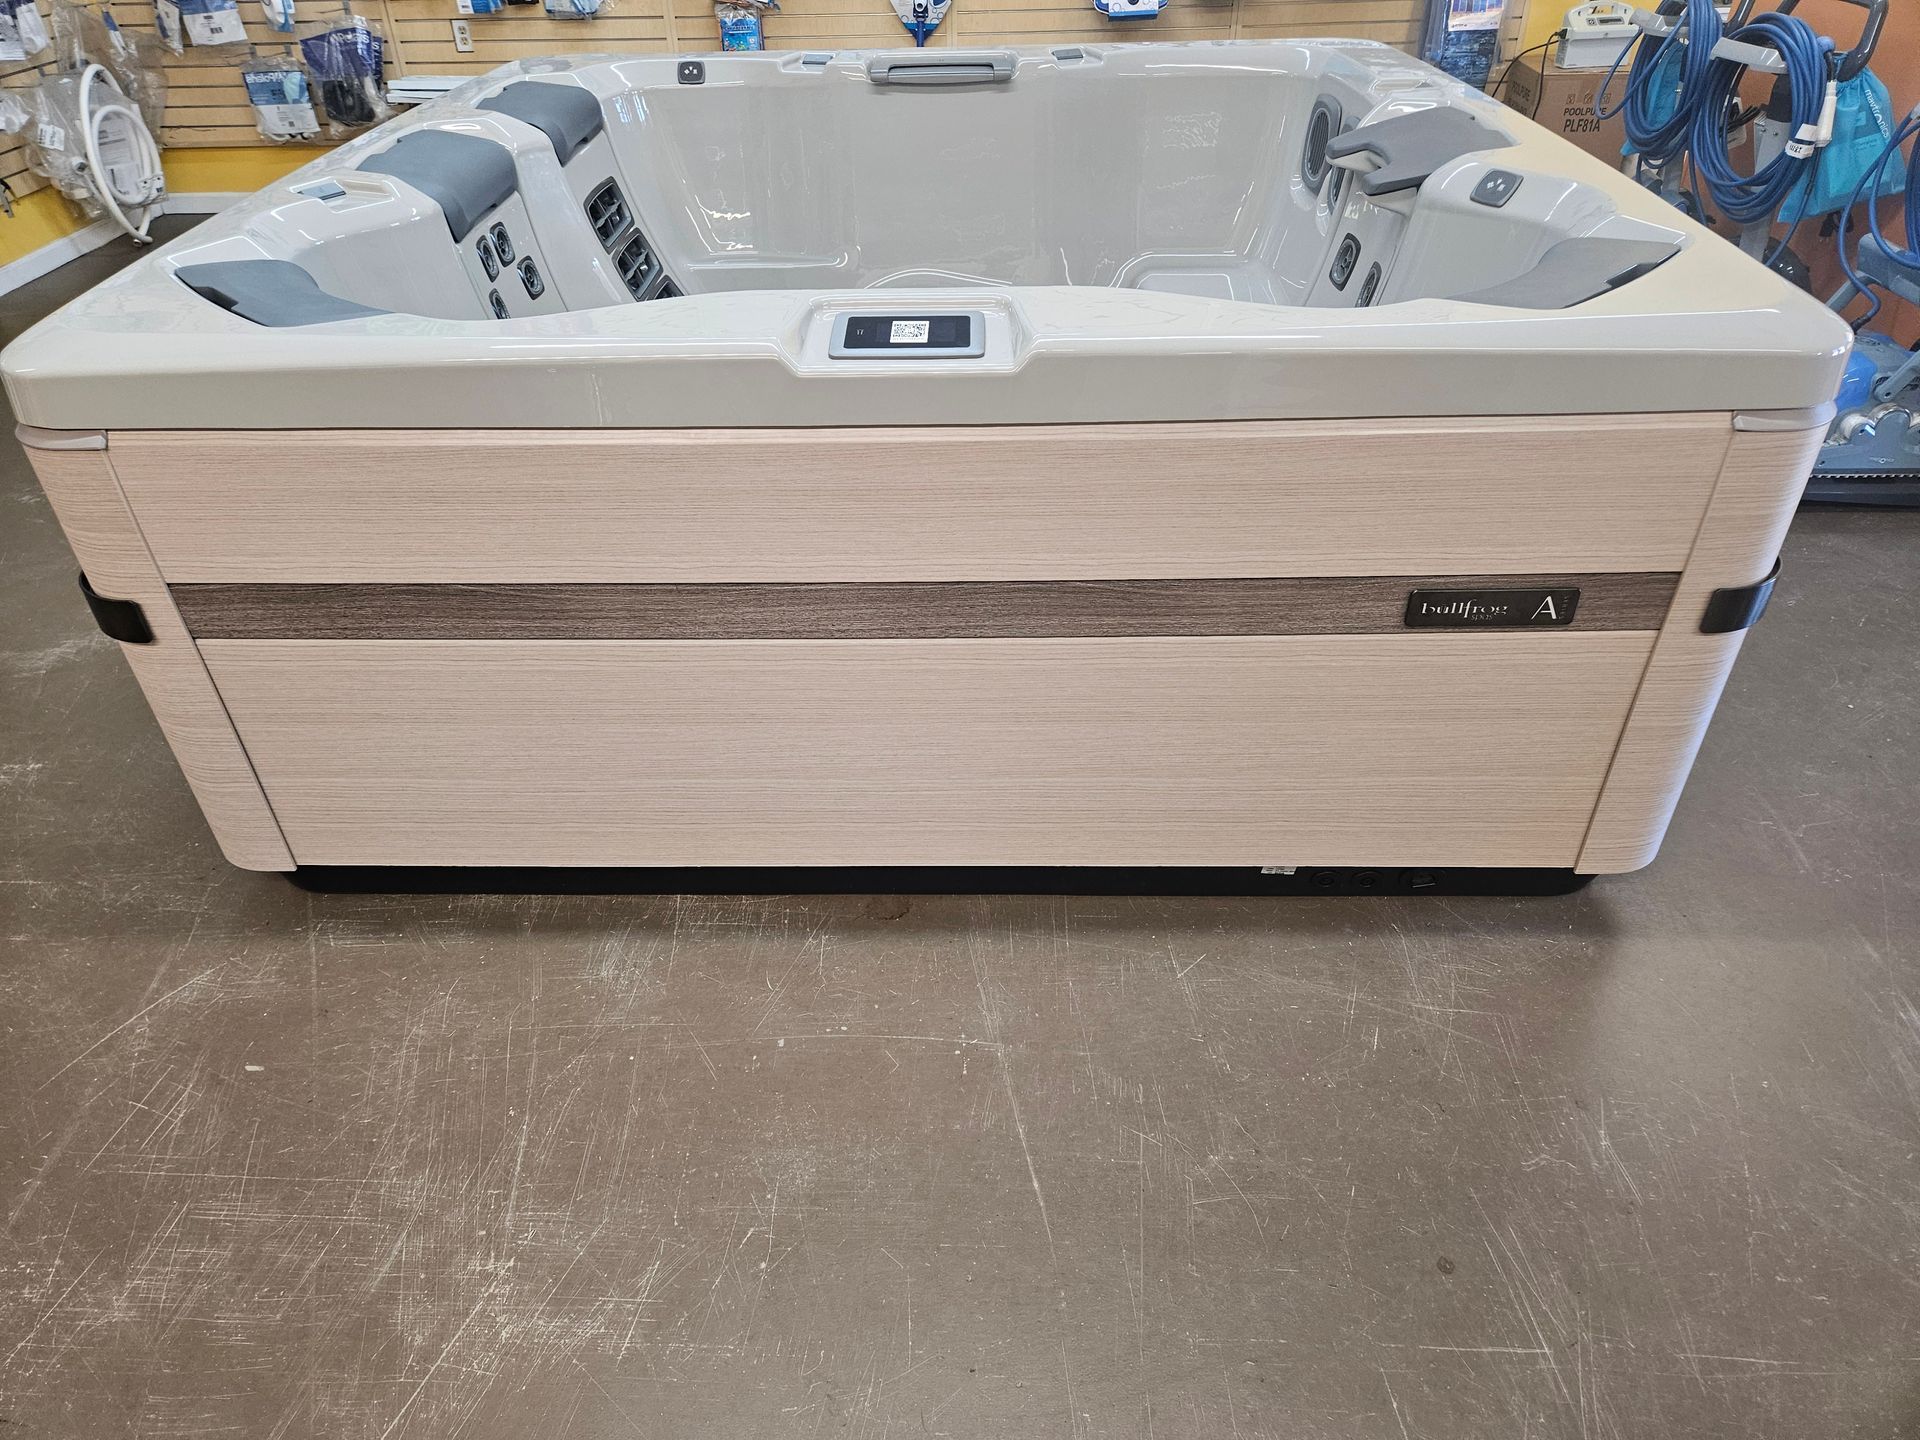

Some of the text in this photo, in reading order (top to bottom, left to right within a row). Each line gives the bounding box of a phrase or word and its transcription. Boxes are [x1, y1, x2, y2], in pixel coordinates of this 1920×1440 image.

[1563, 119, 1601, 132] PLF81A
[1421, 599, 1508, 618] bullfrog
[1531, 595, 1557, 620] A
